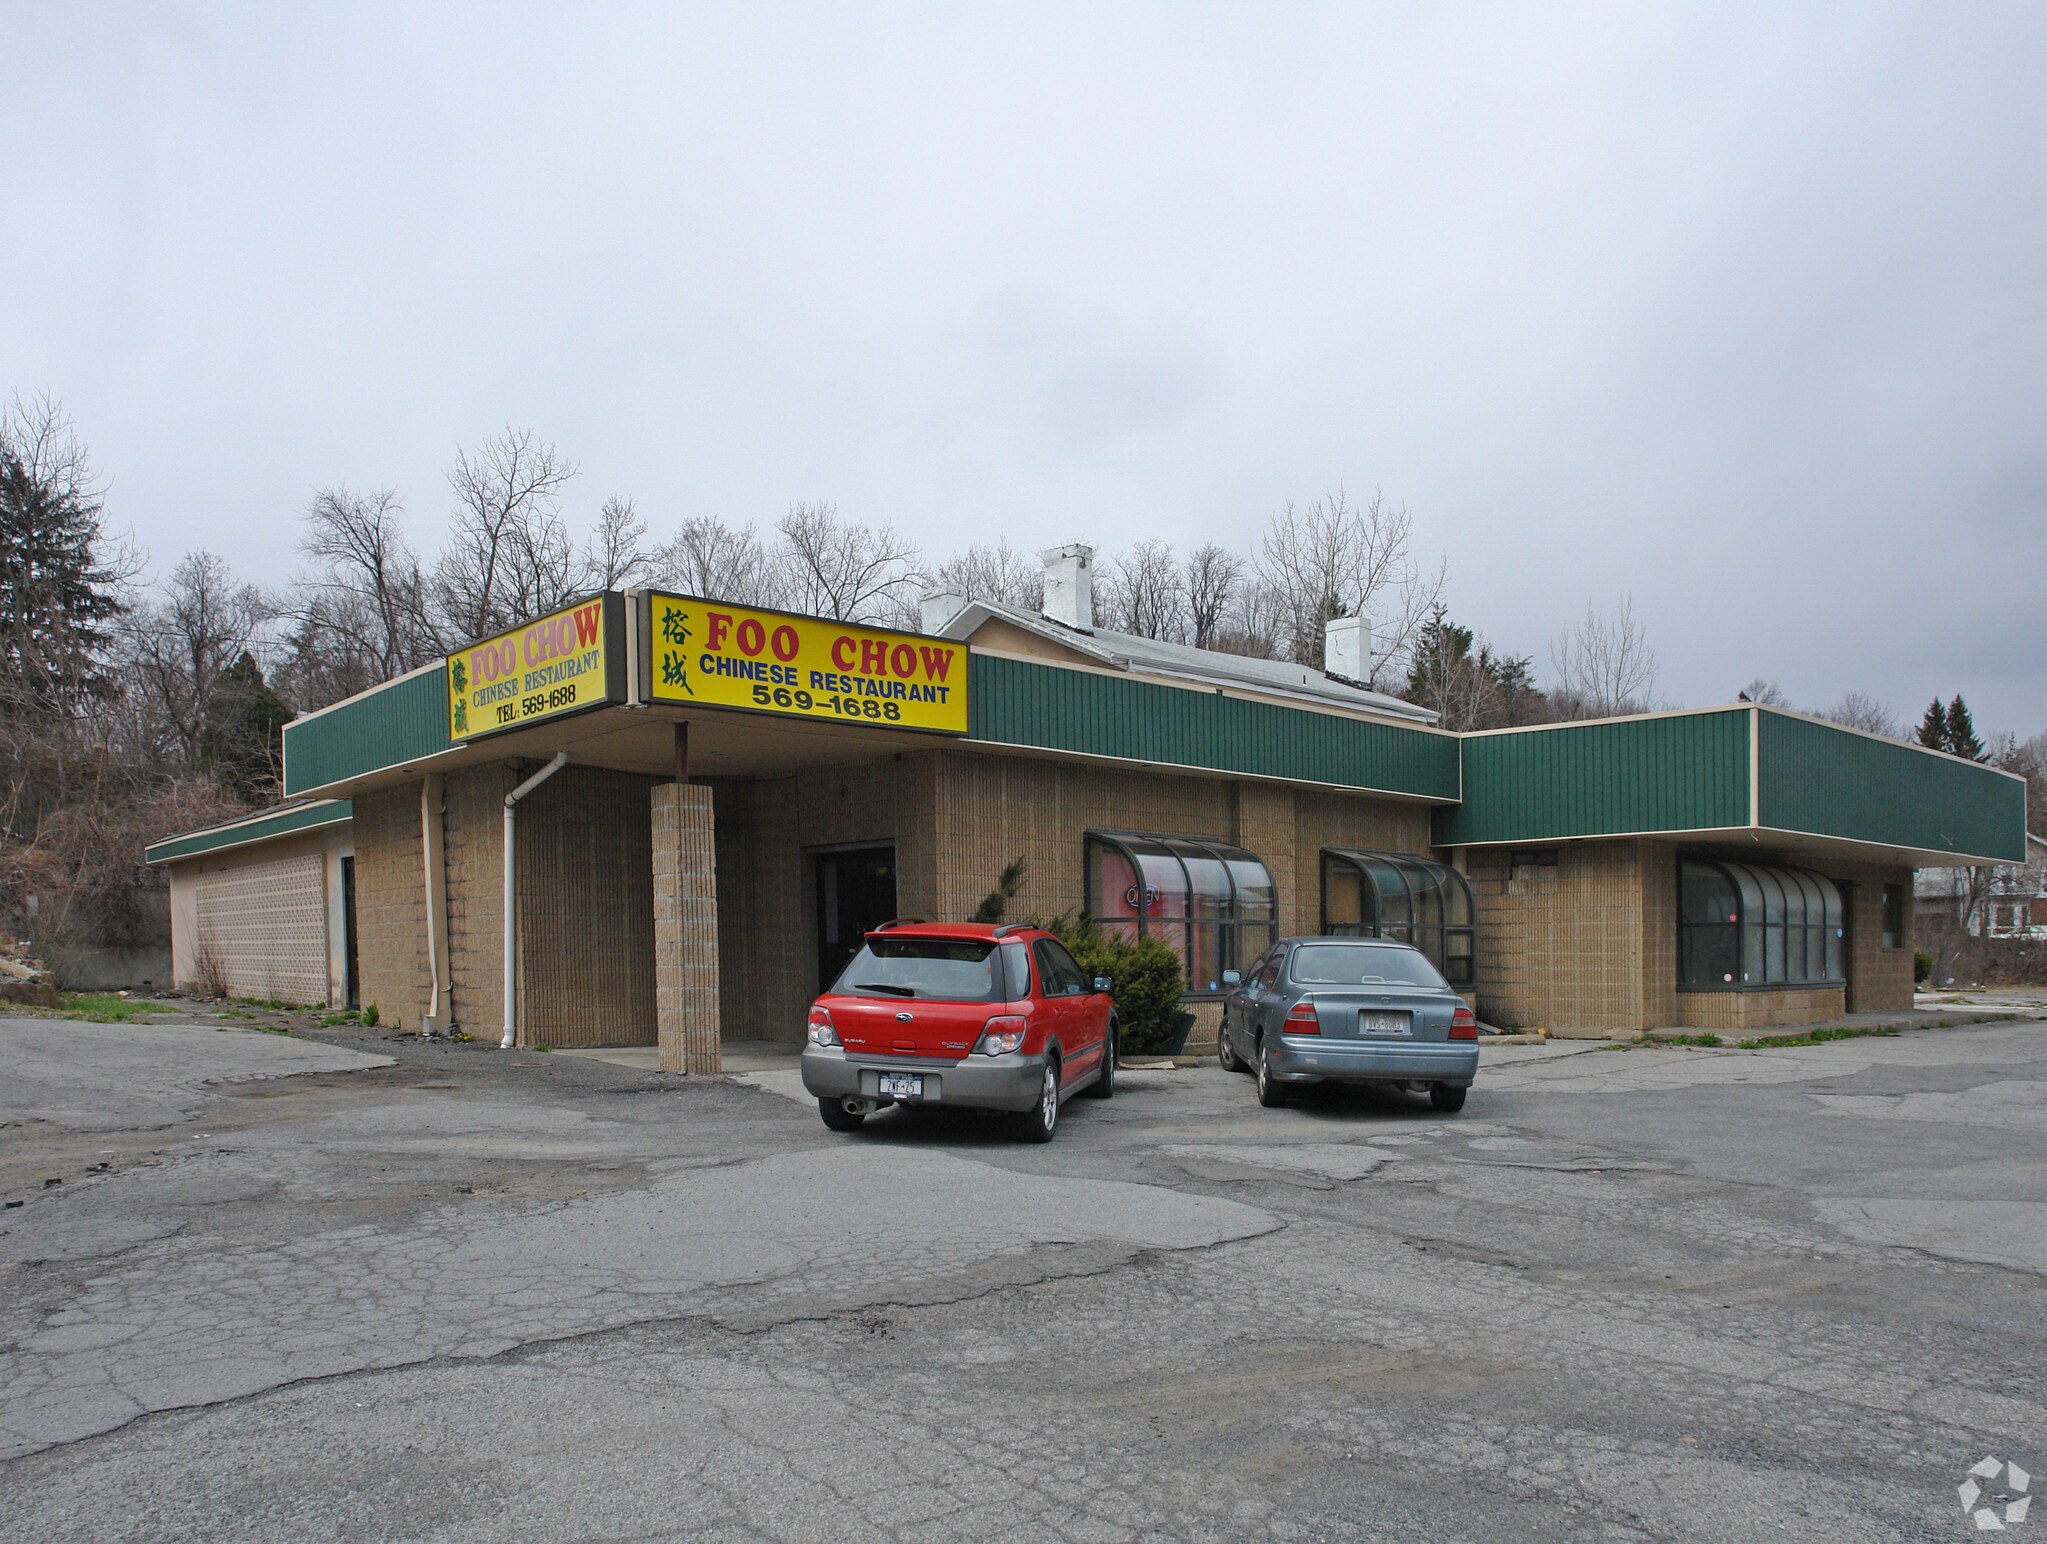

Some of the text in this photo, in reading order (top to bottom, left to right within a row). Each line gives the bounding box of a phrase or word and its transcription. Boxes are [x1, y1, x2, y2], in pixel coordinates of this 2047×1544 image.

[470, 603, 601, 686] FOO CHOW
[704, 611, 955, 683] FOO CHOW
[472, 649, 600, 708] CHINESE RESTAURANT
[496, 684, 576, 724] TEL: 569-1688
[699, 653, 950, 704] CHINESE RESTAURANT
[752, 684, 901, 721] 569-1688
